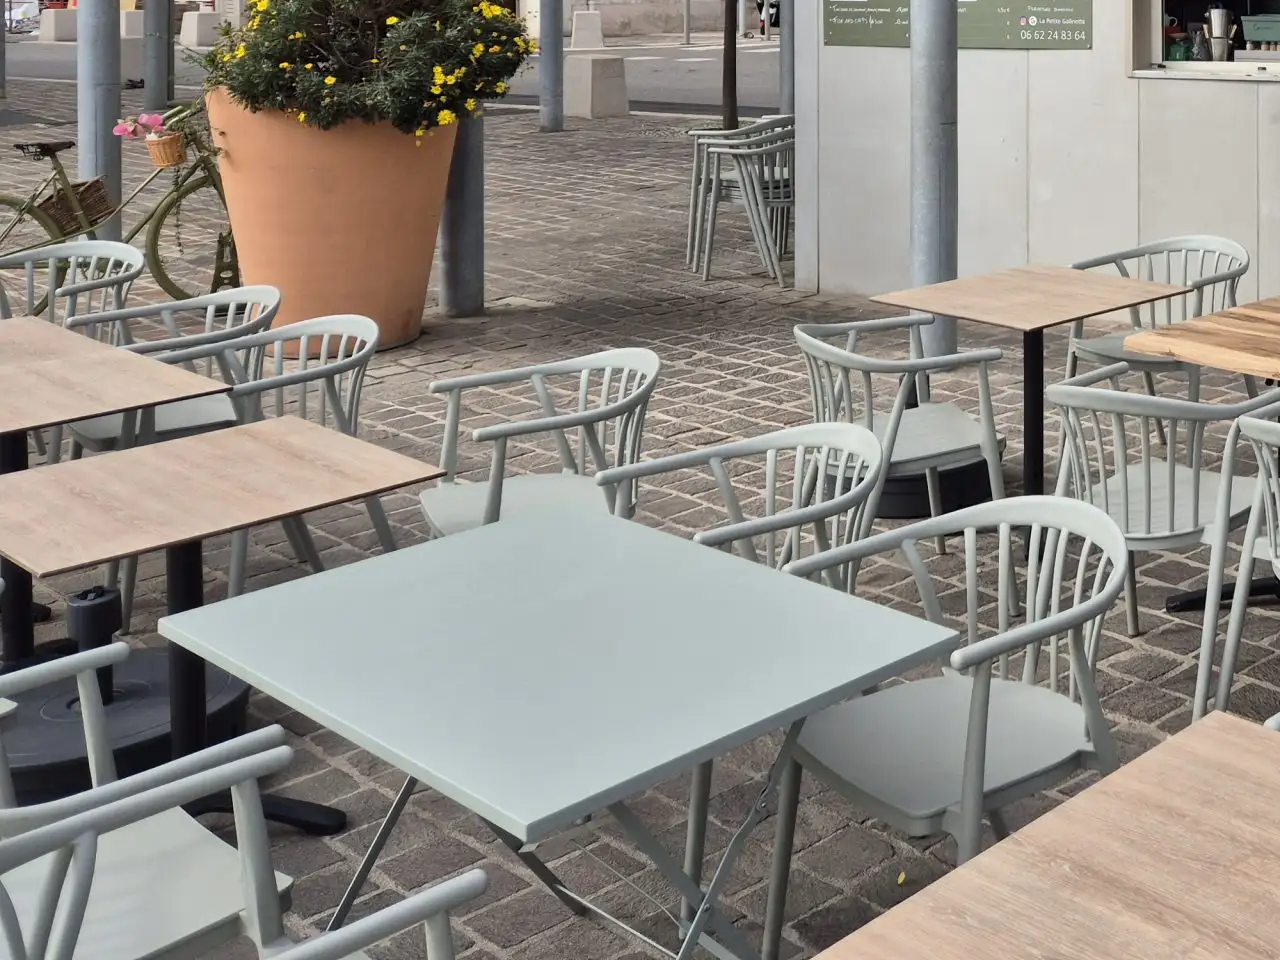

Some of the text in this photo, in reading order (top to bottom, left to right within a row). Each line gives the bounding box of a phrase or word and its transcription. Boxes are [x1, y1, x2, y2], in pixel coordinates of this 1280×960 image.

[1021, 30, 1085, 40] 06 62 24 83 64
